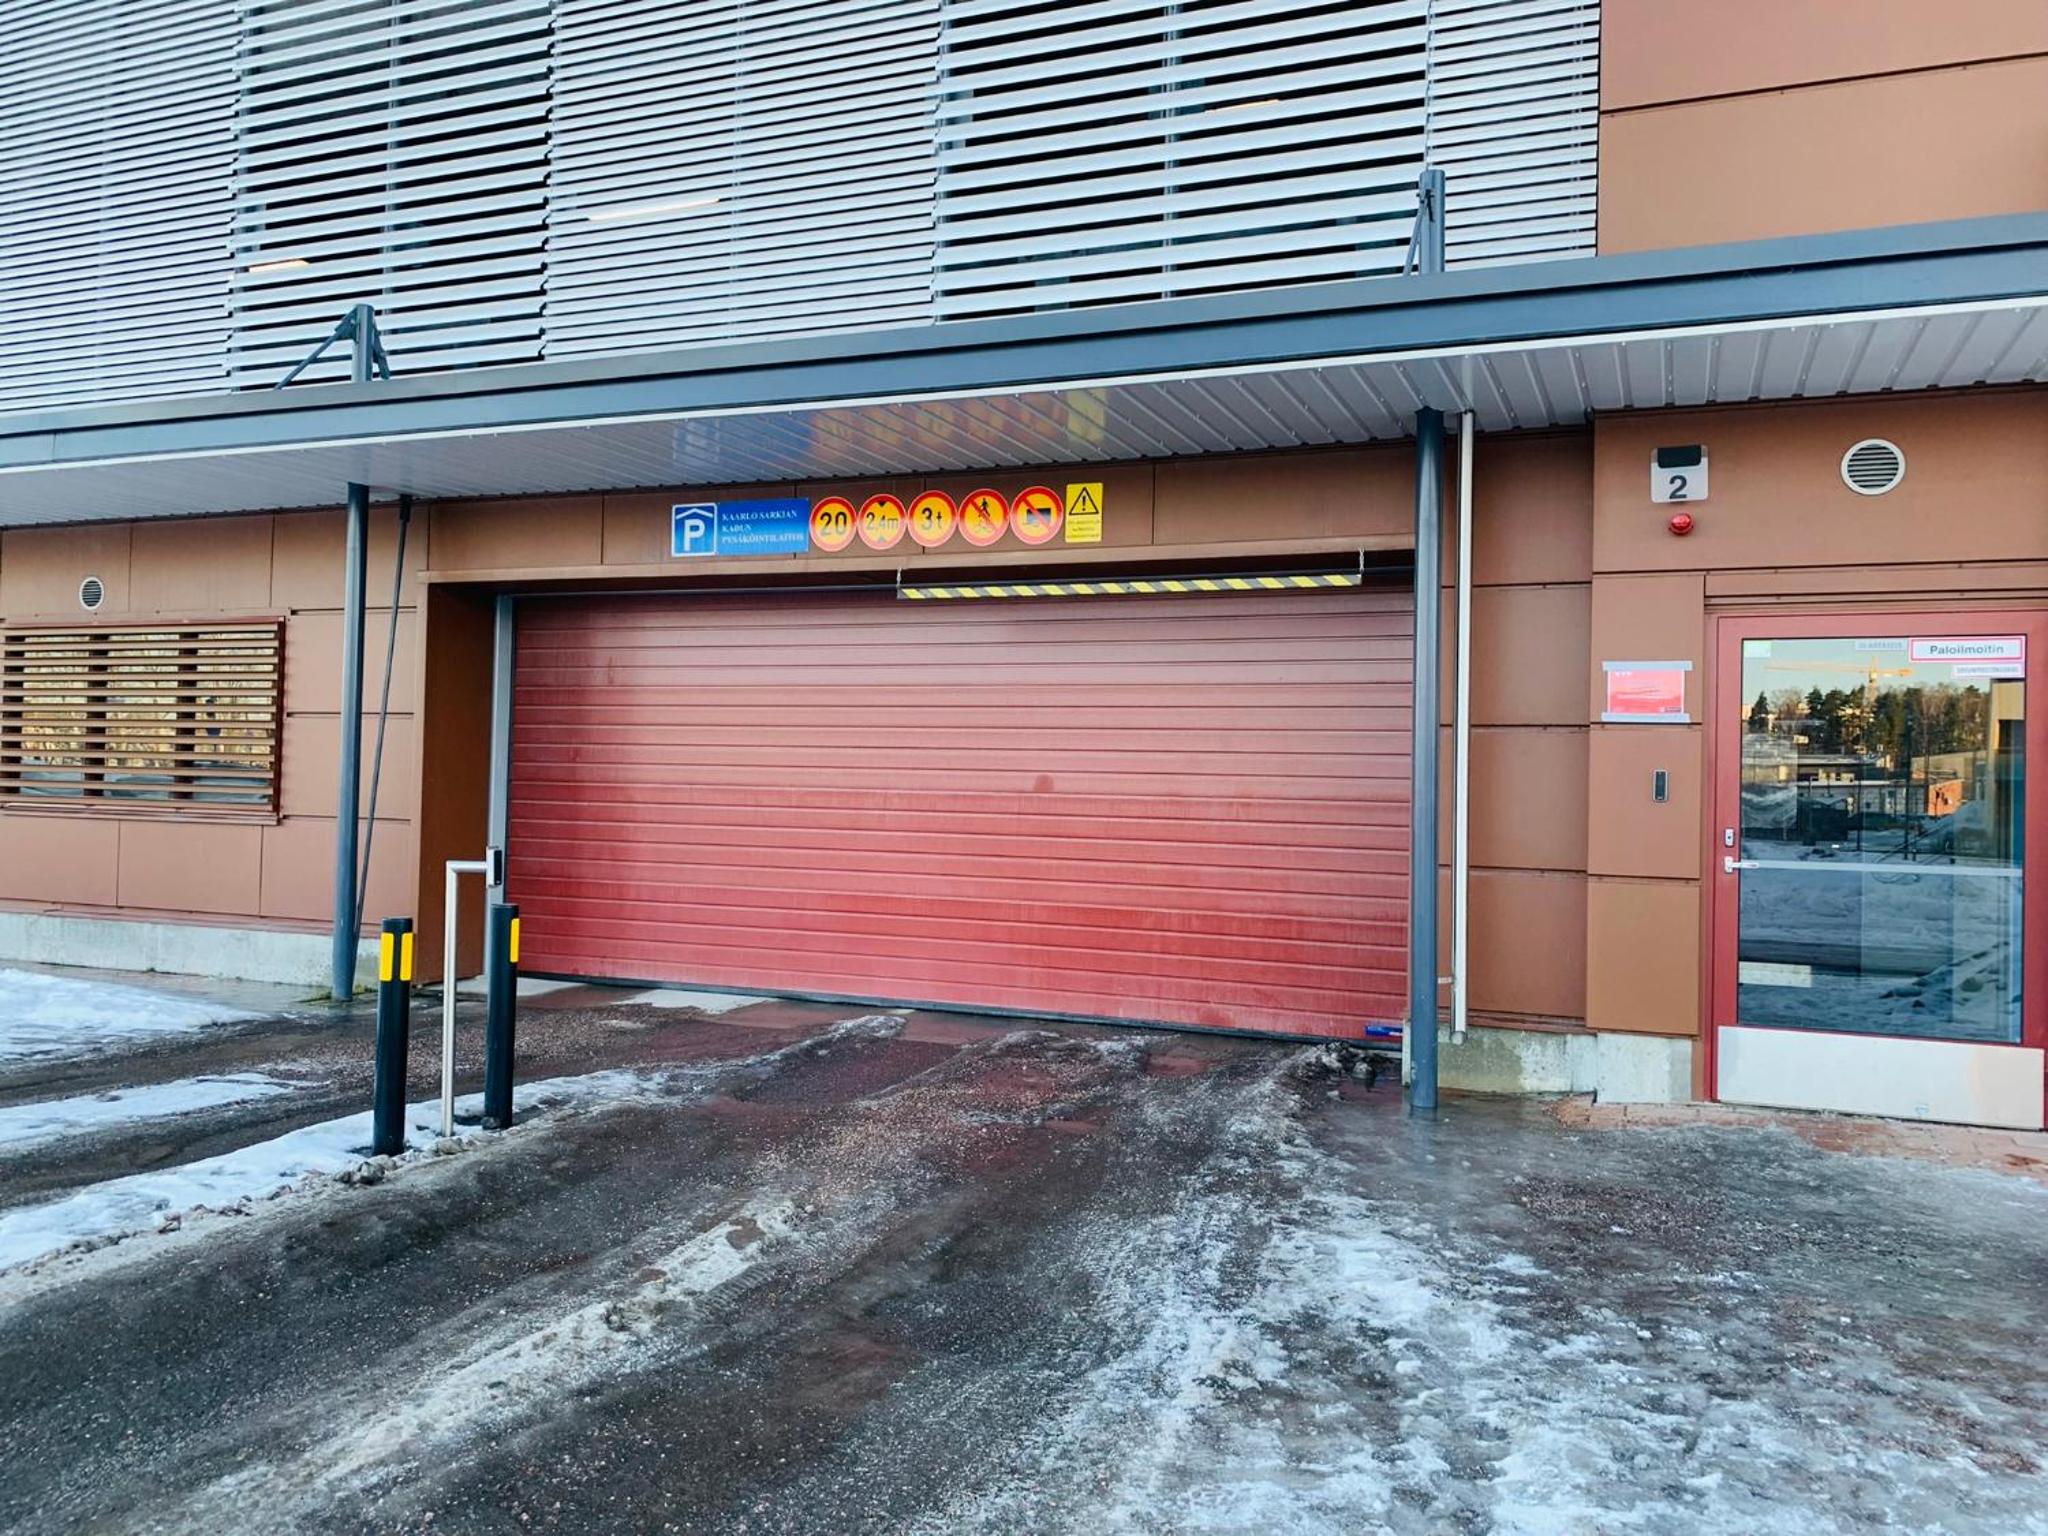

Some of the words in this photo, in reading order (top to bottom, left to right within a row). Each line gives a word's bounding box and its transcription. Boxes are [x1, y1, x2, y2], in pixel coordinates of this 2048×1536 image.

[1669, 474, 1688, 499] 2
[721, 511, 758, 521] KAARLO
[759, 509, 798, 520] SARKIAN
[820, 511, 848, 536] 20
[684, 518, 706, 551] P
[1929, 645, 2004, 655] Paloilmoitin
